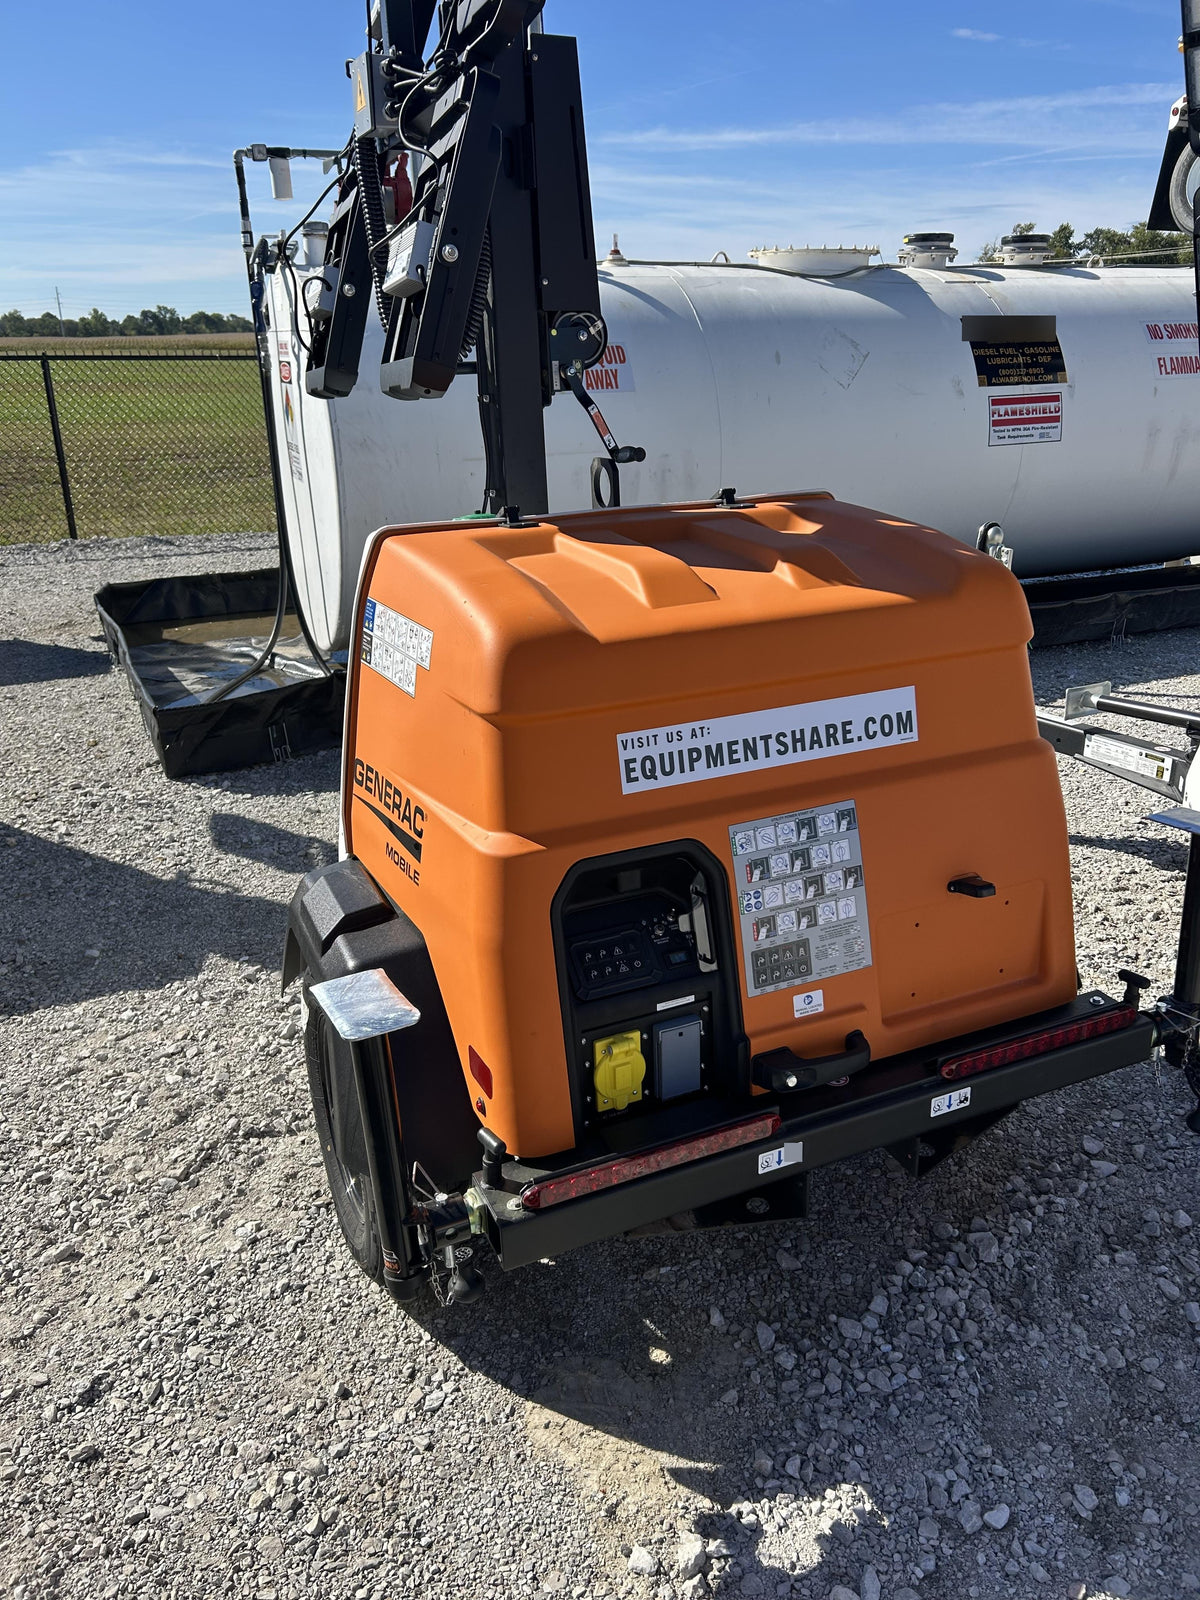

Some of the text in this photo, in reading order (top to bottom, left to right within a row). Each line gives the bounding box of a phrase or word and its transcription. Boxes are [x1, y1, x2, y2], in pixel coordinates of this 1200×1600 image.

[1146, 323, 1164, 340] NO
[973, 345, 1060, 356] DIESEL FUEL GASOLINE
[986, 355, 1052, 365] LUBRICANTS DEF
[585, 368, 619, 390] AWAY
[991, 403, 1061, 418] FLAMESHIELD
[621, 726, 711, 751] VISIT US AT:
[624, 710, 914, 784] EQUIPMENTSHARE.COM
[354, 758, 424, 839] GENERAC
[386, 842, 420, 887] MOBILE
